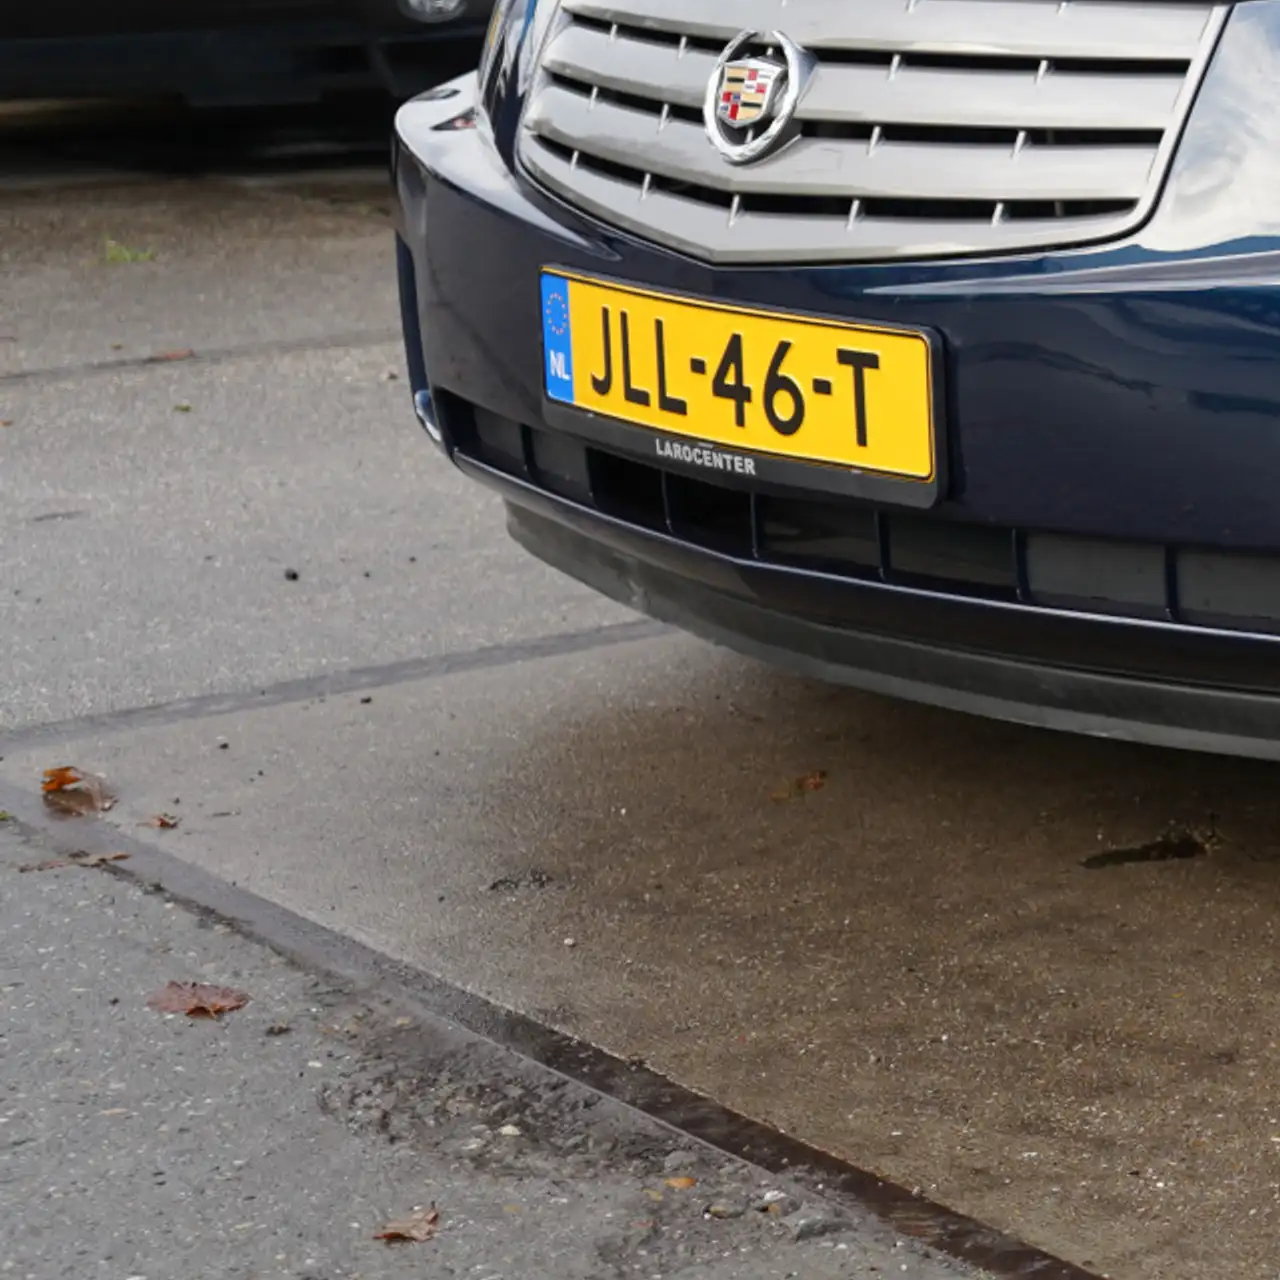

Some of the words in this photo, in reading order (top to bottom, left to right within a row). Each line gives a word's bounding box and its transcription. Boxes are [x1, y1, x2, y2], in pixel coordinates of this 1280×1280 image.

[549, 348, 572, 381] NL
[590, 305, 881, 448] JLL-46-T
[655, 437, 757, 476] LAROCENTER
